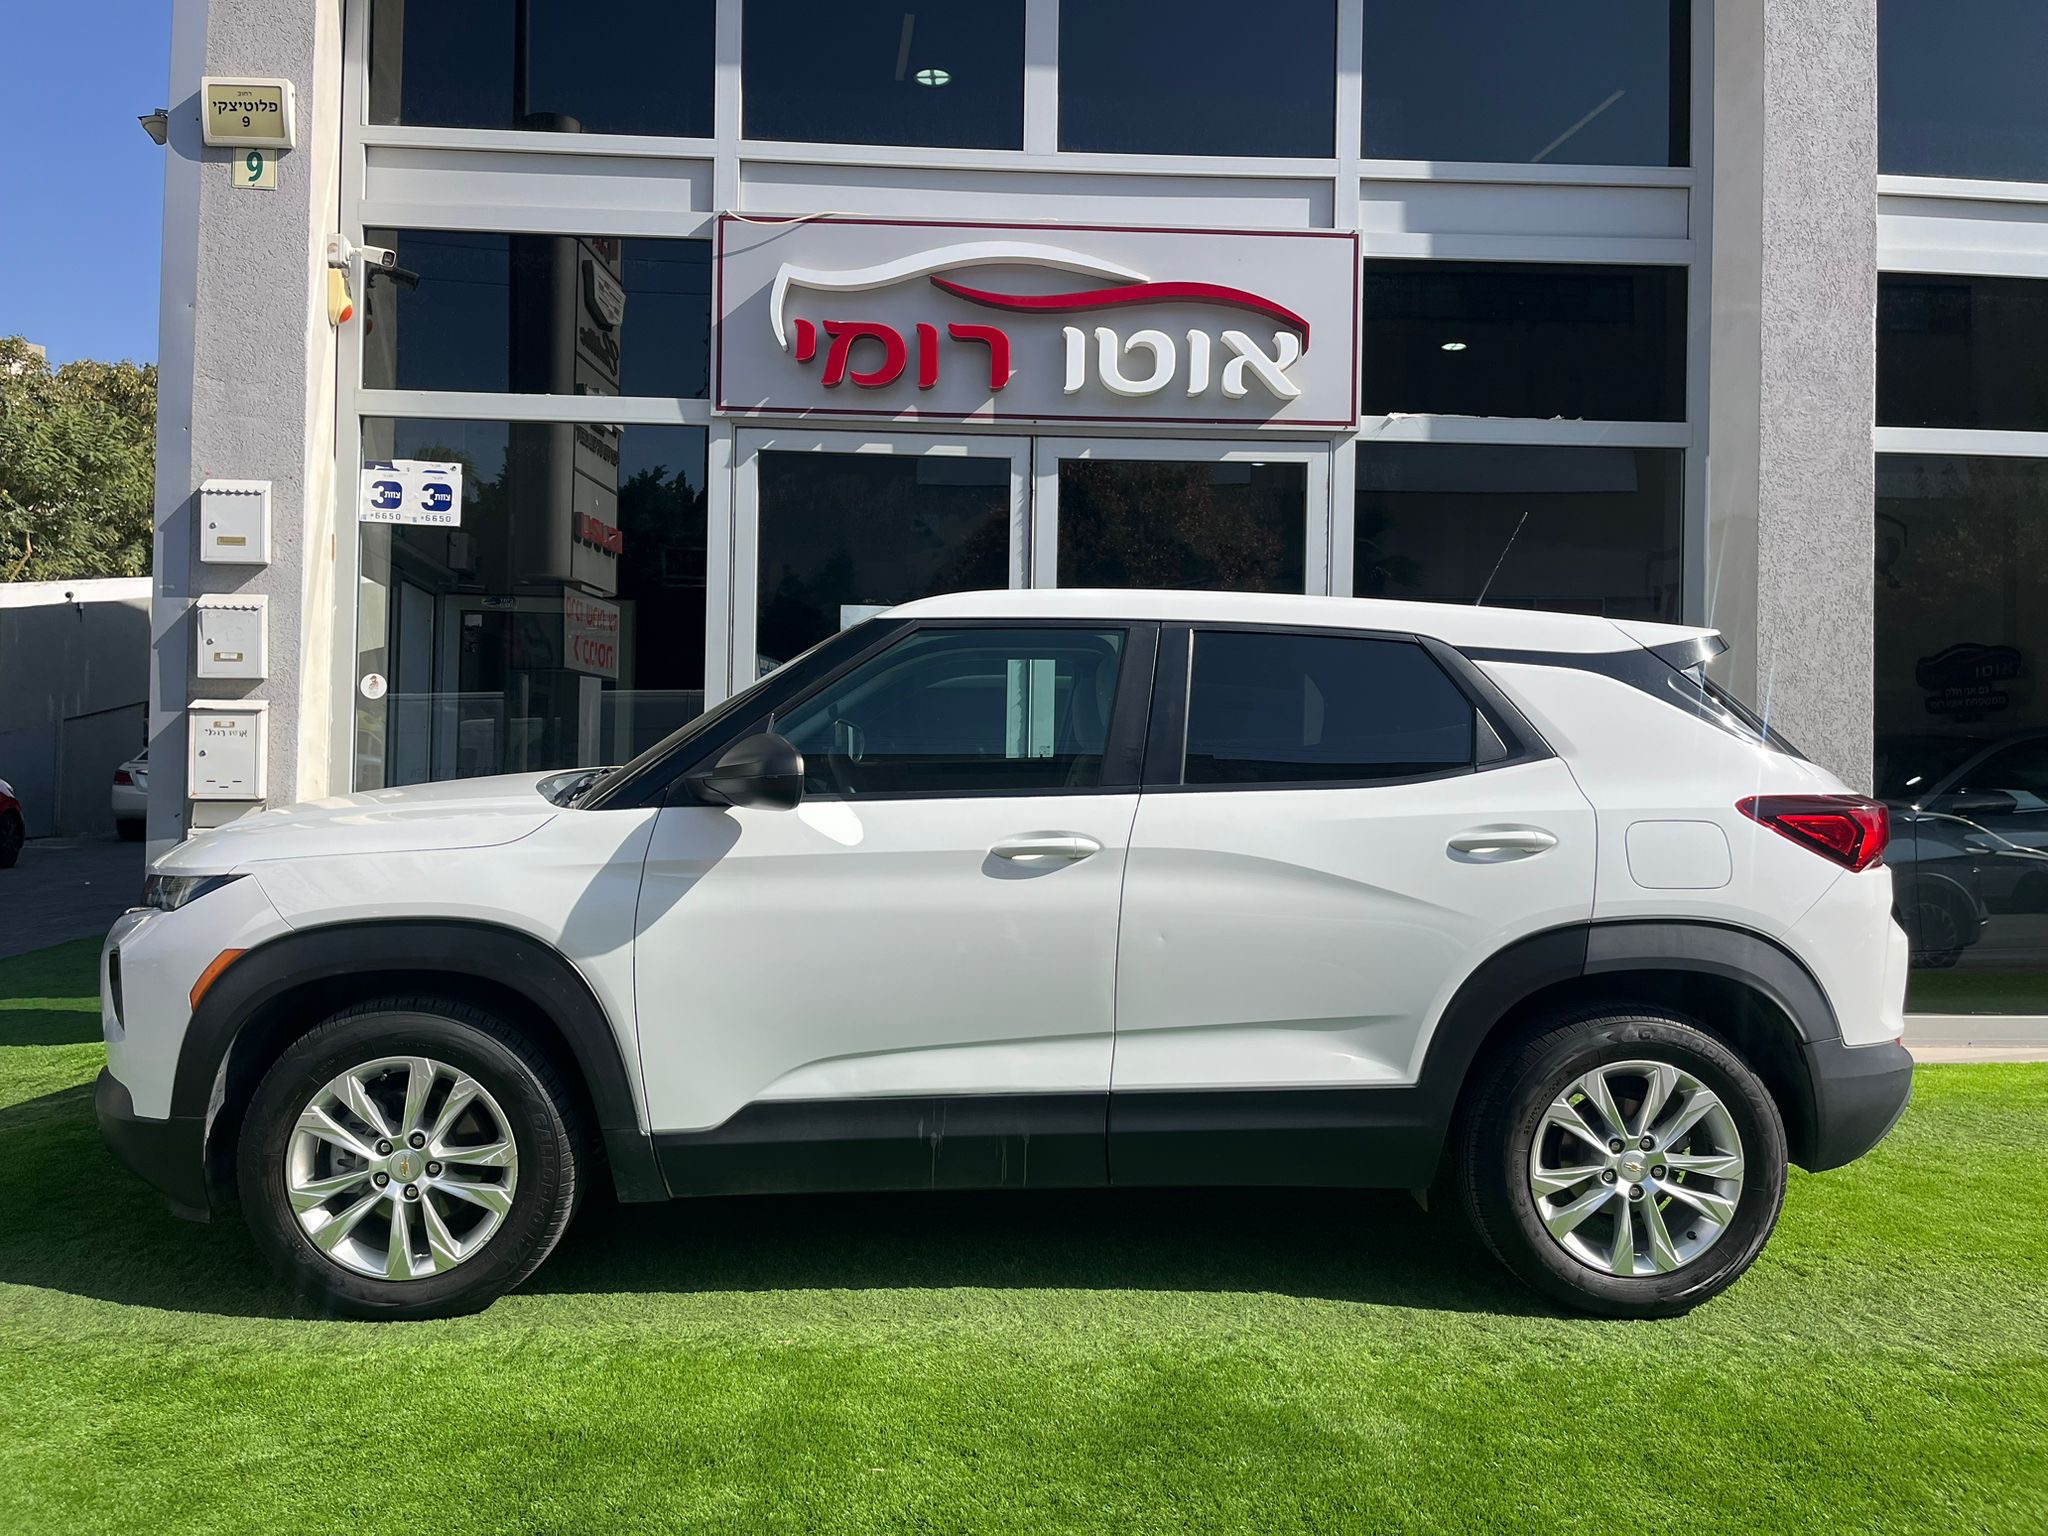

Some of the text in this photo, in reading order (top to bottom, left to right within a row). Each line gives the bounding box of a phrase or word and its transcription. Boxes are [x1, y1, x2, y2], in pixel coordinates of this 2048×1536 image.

[212, 99, 278, 115] פלוטיצקי
[242, 115, 251, 127] 9
[246, 151, 264, 182] 9
[794, 318, 1304, 401] אוטו רומי
